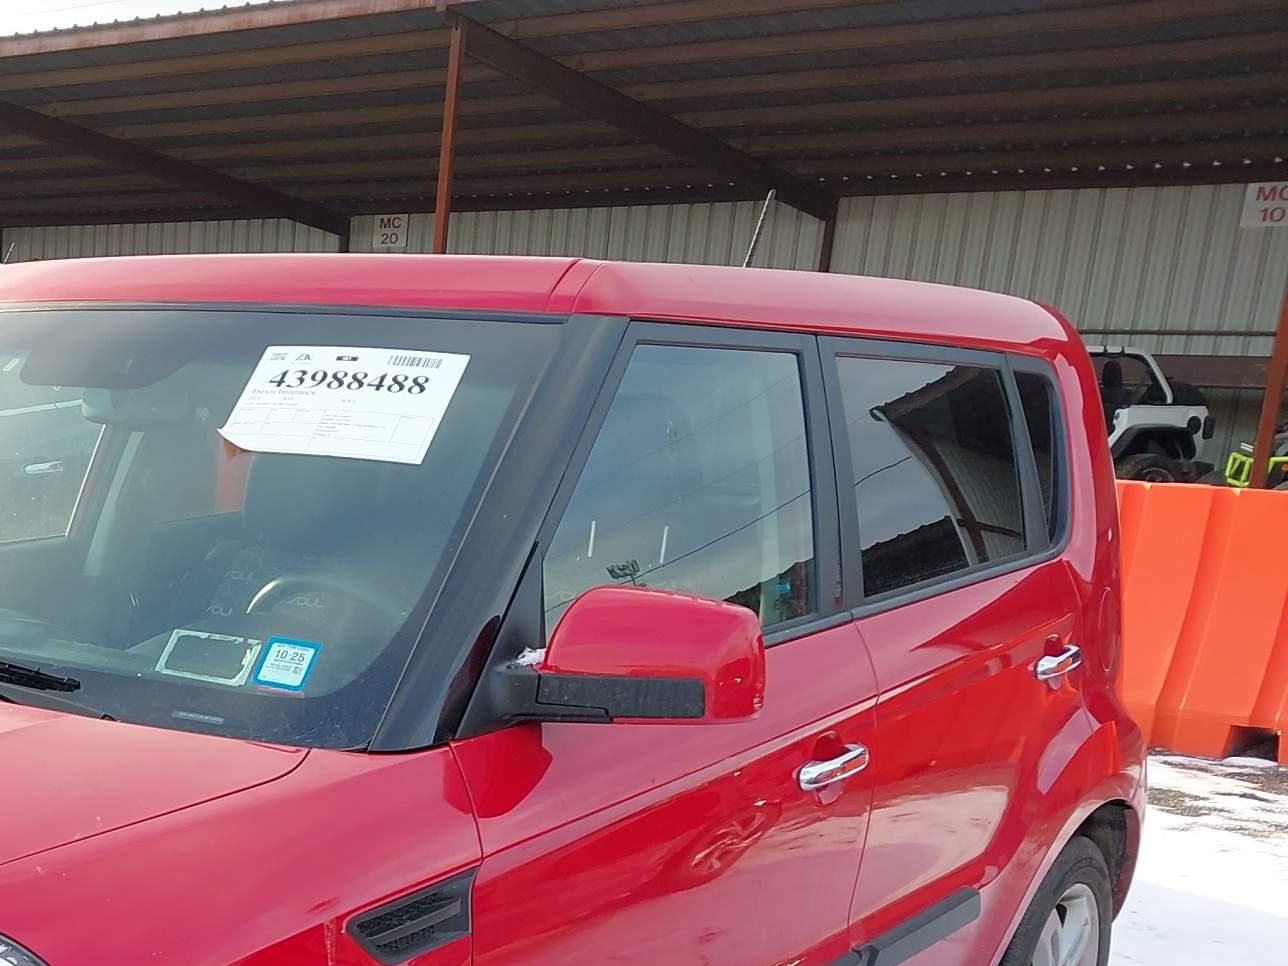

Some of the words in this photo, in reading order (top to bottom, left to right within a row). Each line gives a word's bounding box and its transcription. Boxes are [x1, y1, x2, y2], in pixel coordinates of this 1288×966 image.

[1260, 207, 1286, 222] 10
[380, 217, 402, 229] MC
[380, 232, 399, 244] 20
[268, 369, 430, 395] 43988488
